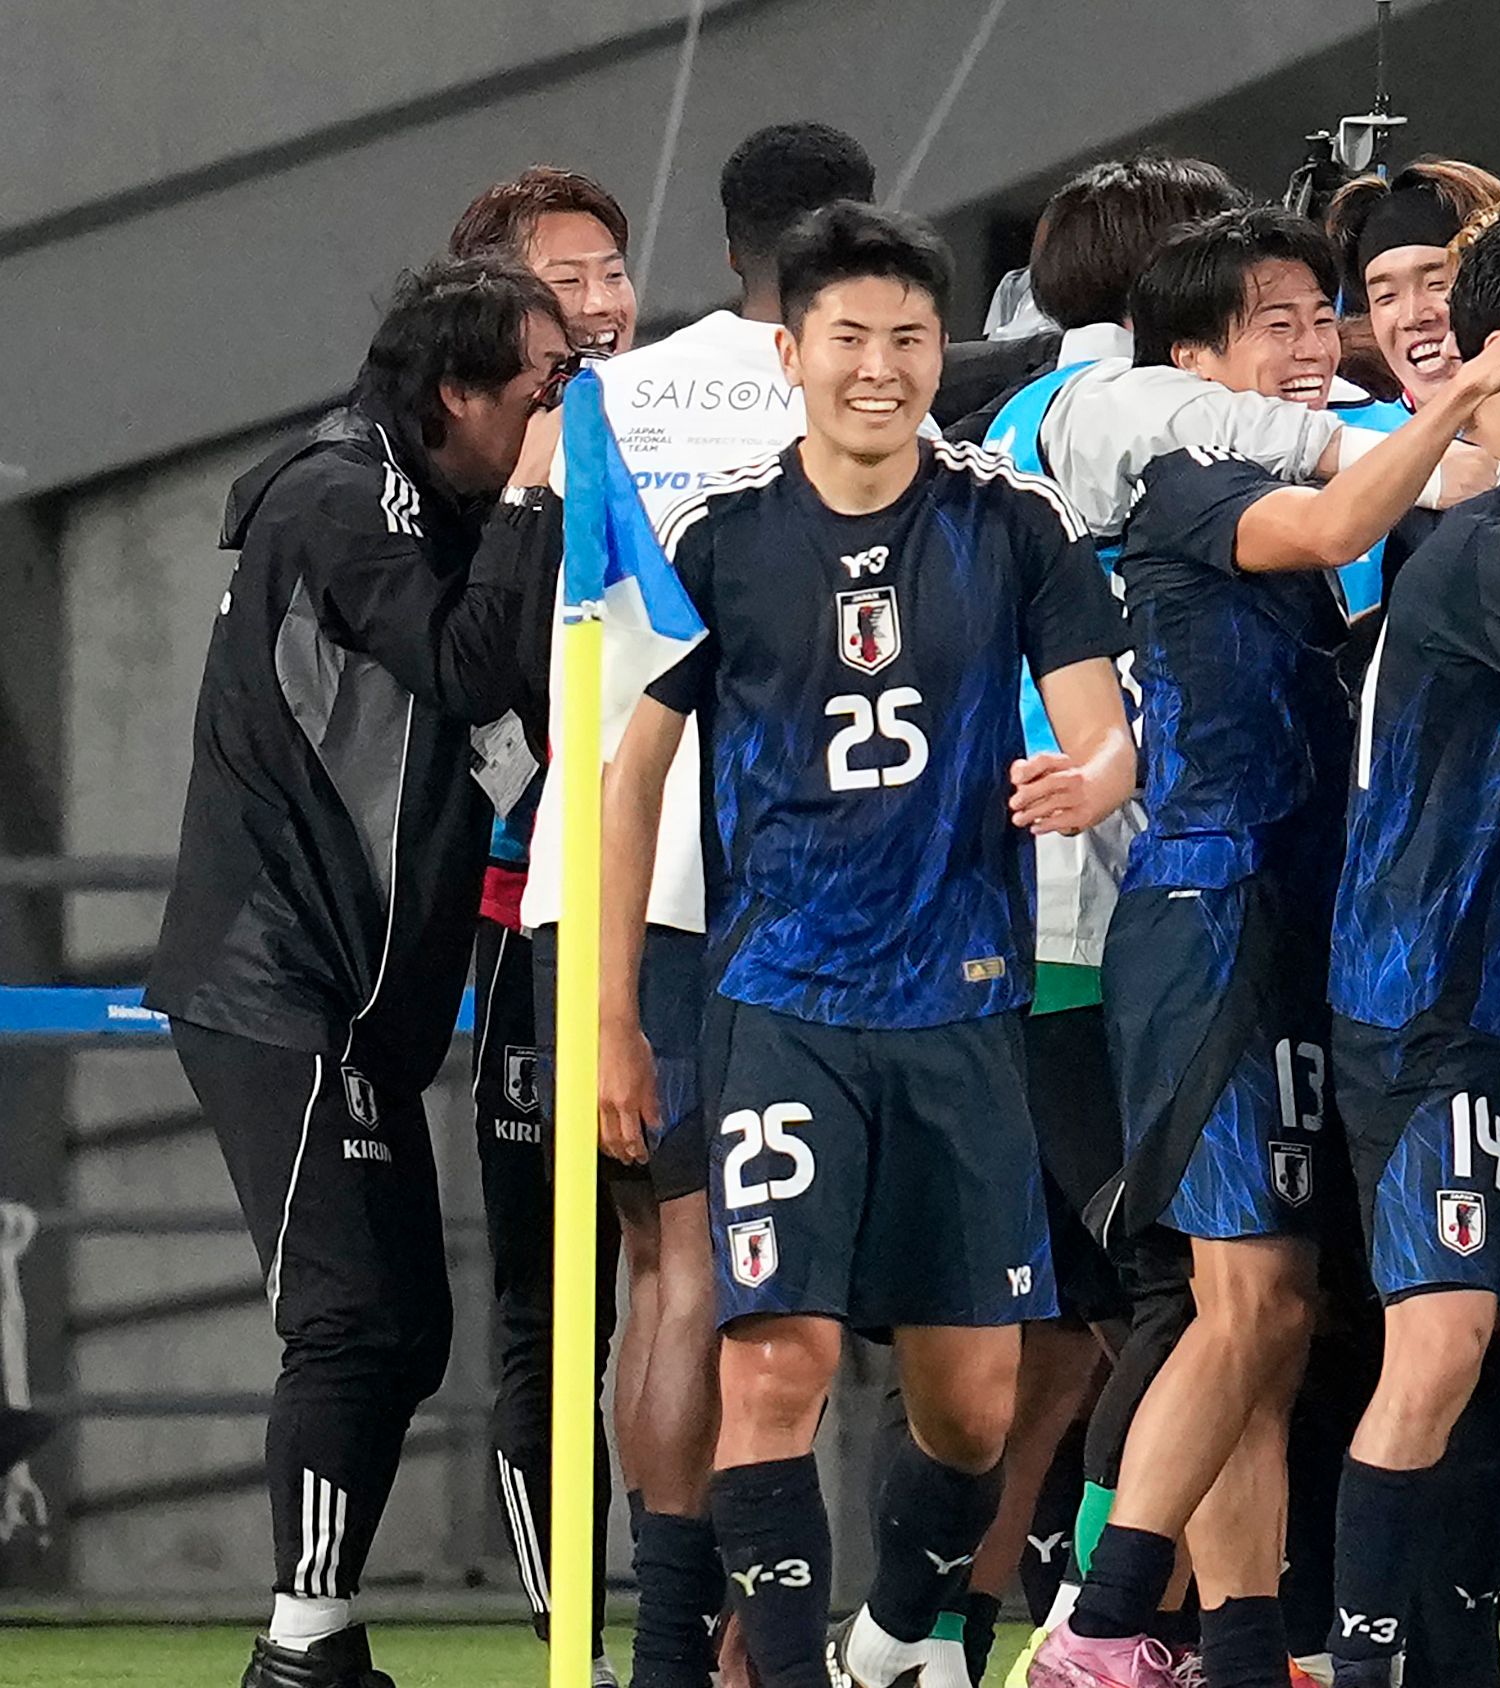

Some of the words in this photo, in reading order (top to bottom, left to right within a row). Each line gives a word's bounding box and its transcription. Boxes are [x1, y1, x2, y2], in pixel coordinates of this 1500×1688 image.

[631, 379, 793, 411] SAISON
[619, 435, 672, 444] NATIONAL
[628, 427, 665, 435] JAPAN
[632, 471, 691, 489] OYO
[840, 545, 889, 578] Y-3
[825, 687, 928, 792] 25
[1275, 1038, 1325, 1132] 13
[494, 1118, 542, 1144] KIRI
[720, 1102, 815, 1209] 25
[731, 1559, 812, 1597] Y-3
[1338, 1607, 1399, 1644] Y-3
